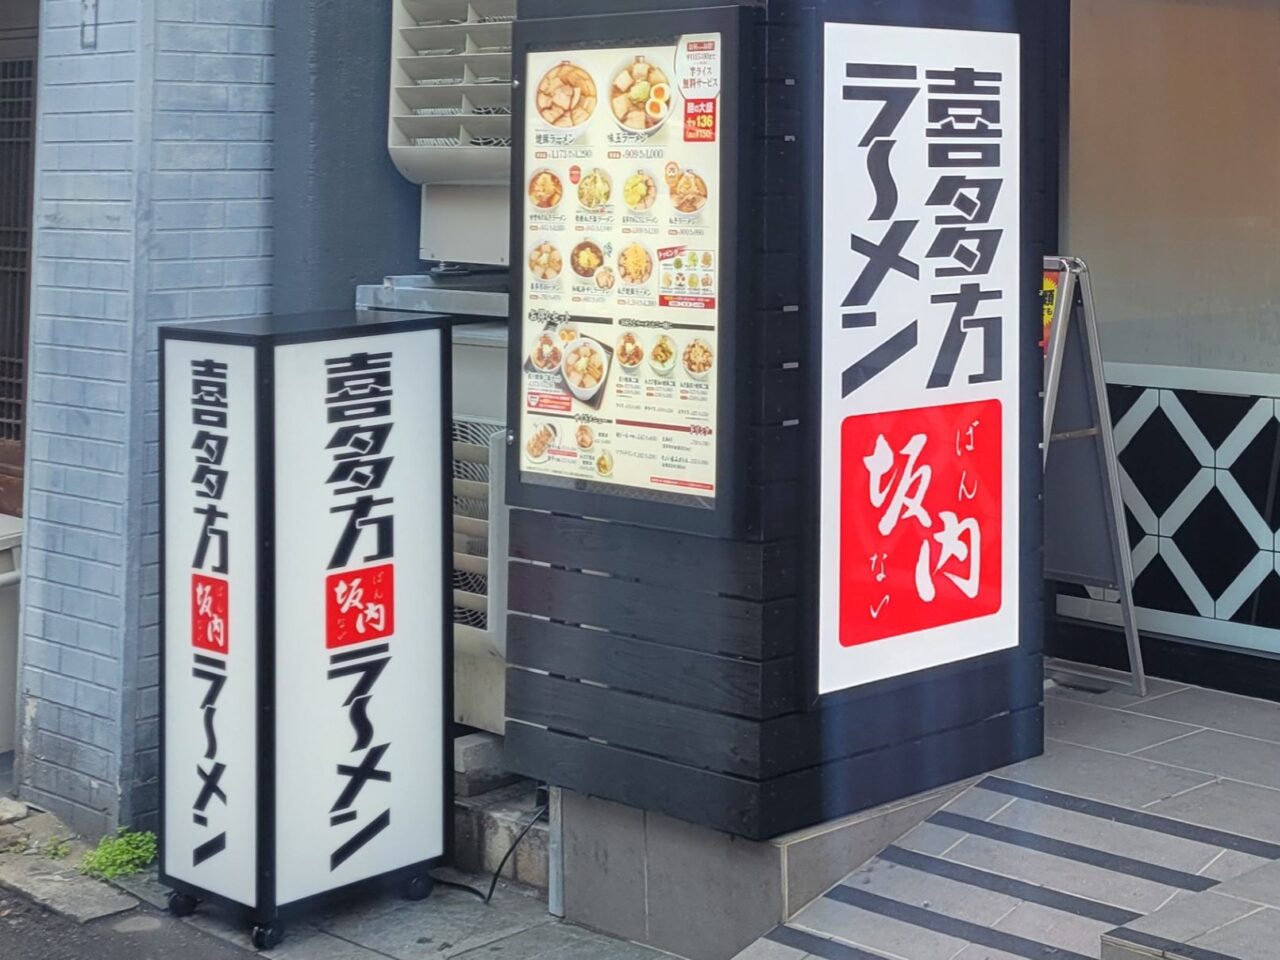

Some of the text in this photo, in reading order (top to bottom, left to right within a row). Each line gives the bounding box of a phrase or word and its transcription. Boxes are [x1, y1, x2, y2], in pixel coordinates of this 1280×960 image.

[925, 68, 1003, 388] 喜多方
[191, 359, 228, 575] 喜多方
[325, 352, 394, 570] 喜多方
[863, 434, 980, 602] 坂内
[956, 421, 980, 501] ばん
[196, 583, 224, 647] 坂内
[334, 578, 386, 634] 坂内
[869, 552, 890, 619] ない
